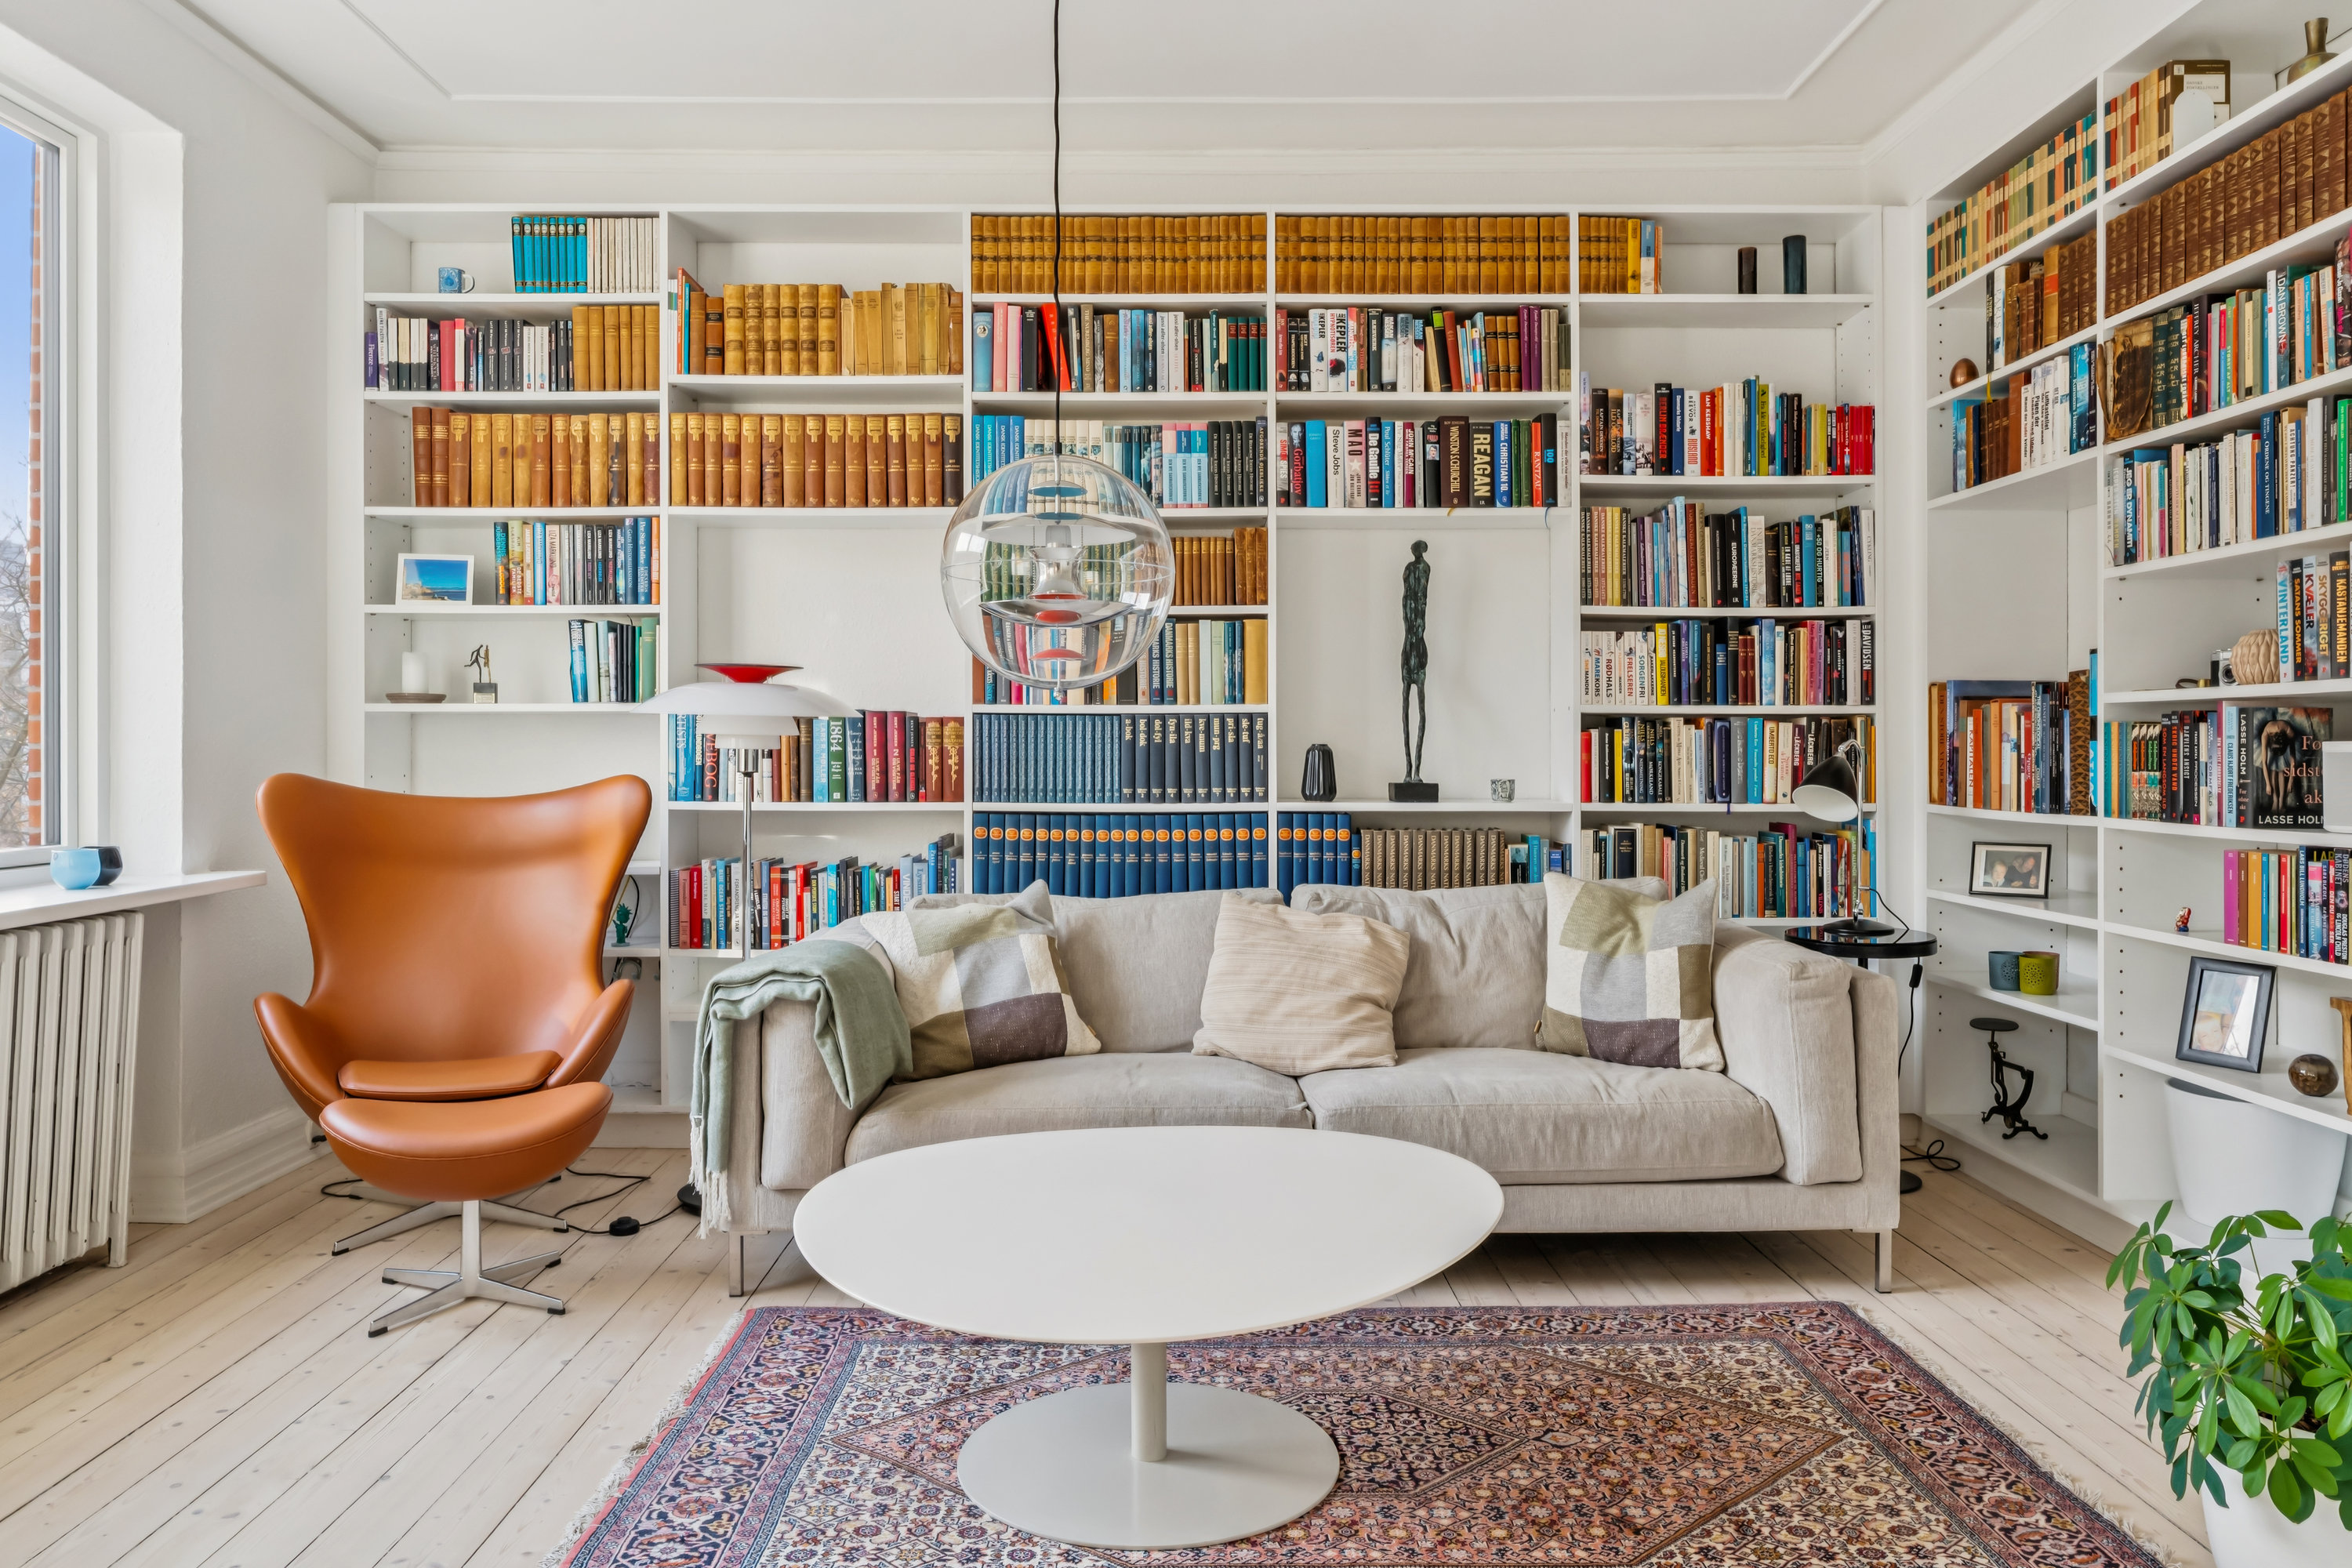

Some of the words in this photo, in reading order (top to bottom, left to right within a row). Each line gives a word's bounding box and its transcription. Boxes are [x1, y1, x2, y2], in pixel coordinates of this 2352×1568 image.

[2278, 278, 2286, 301] DAN
[1336, 318, 1345, 352] KEPLER
[2278, 303, 2286, 343] BROWN
[1659, 397, 1668, 422] BERLIN
[1348, 429, 1363, 456] MAO
[1369, 433, 1379, 446] De
[1450, 426, 1459, 453] WINSTON
[1659, 424, 1668, 459] BRÆNDER
[1369, 448, 1379, 479] Gaulle
[1473, 434, 1490, 496] REAGAN
[1546, 448, 1555, 463] 100
[1293, 448, 1303, 495] Gorbatjov
[1817, 546, 1823, 557] OG
[2305, 573, 2314, 629] KVÆLER
[2278, 577, 2288, 664] VINTERLAND
[2318, 575, 2328, 656] SKYGGERIGET
[2336, 579, 2347, 662] KASTANJEMANDEN
[1165, 622, 1174, 659] DANMARKS
[1863, 630, 1871, 670] DAVIDSEN
[1165, 659, 1174, 688] HISTORIE
[830, 720, 843, 752] 1864
[1153, 719, 1162, 742] dol-fyl
[1168, 718, 1177, 744] fyn-ila
[1212, 717, 1221, 750] mun-prg
[1227, 718, 1236, 743] pri-sla
[1242, 718, 1250, 743] sle-tuf
[2302, 736, 2322, 750] Fo
[1806, 734, 1815, 765] LÄCKBERG
[2162, 746, 2167, 757] EN
[2284, 763, 2323, 777] sidst
[2304, 789, 2322, 804] ak
[2259, 815, 2294, 824] LASSE
